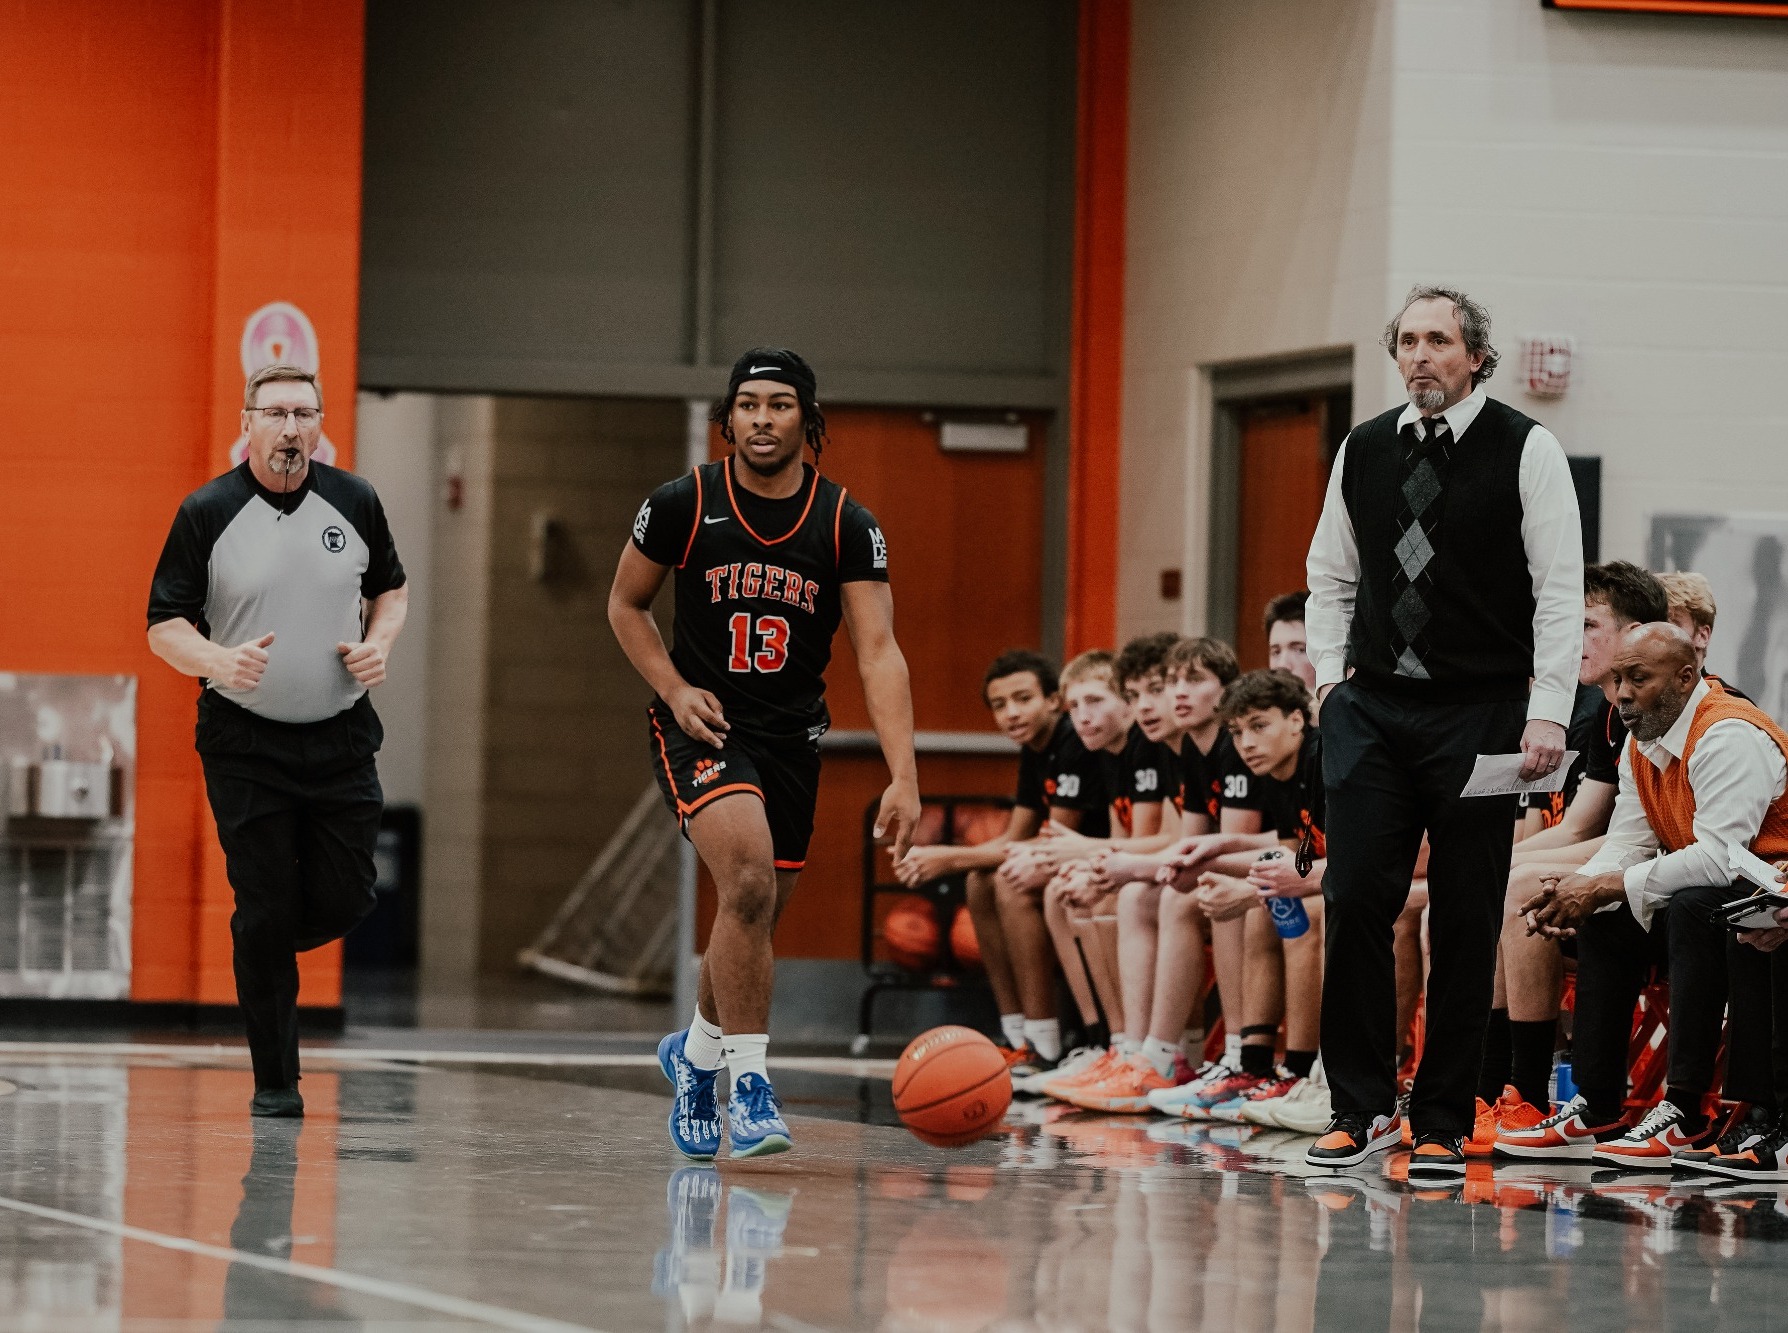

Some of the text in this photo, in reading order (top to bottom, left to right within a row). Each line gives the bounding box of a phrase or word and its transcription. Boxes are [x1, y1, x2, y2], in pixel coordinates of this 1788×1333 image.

[706, 563, 820, 615] TIGERS
[728, 612, 790, 673] 13
[692, 761, 727, 787] TIGERS
[1056, 773, 1080, 798] 30
[1134, 768, 1158, 792] 30
[1224, 774, 1248, 798] 30
